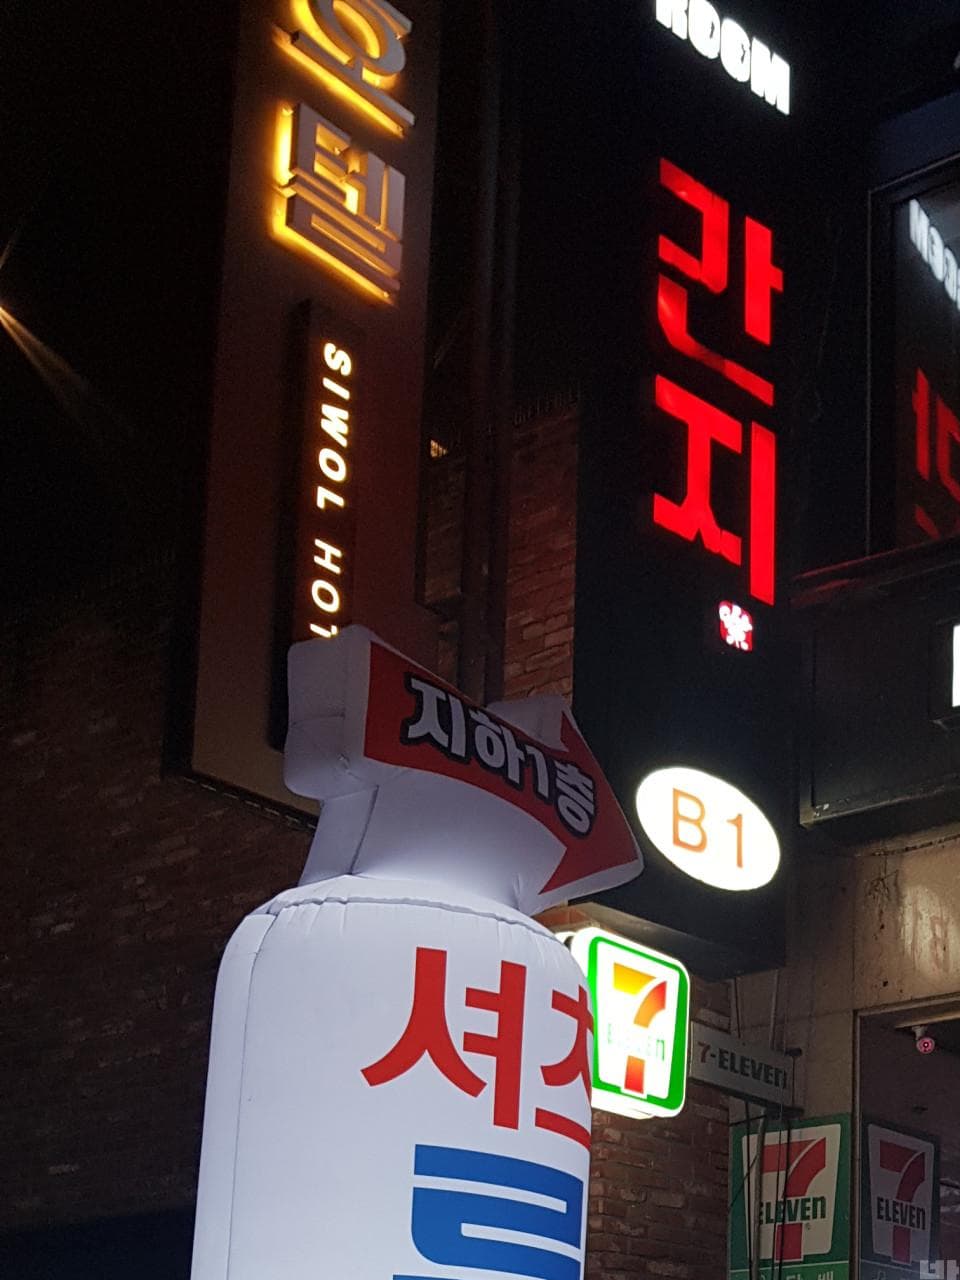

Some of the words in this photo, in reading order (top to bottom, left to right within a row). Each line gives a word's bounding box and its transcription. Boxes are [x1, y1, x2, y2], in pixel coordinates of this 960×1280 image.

[654, 0, 790, 115] ROOM
[315, 342, 353, 511] SIWOL
[652, 157, 785, 605] 간지
[404, 675, 598, 837] 지하1층
